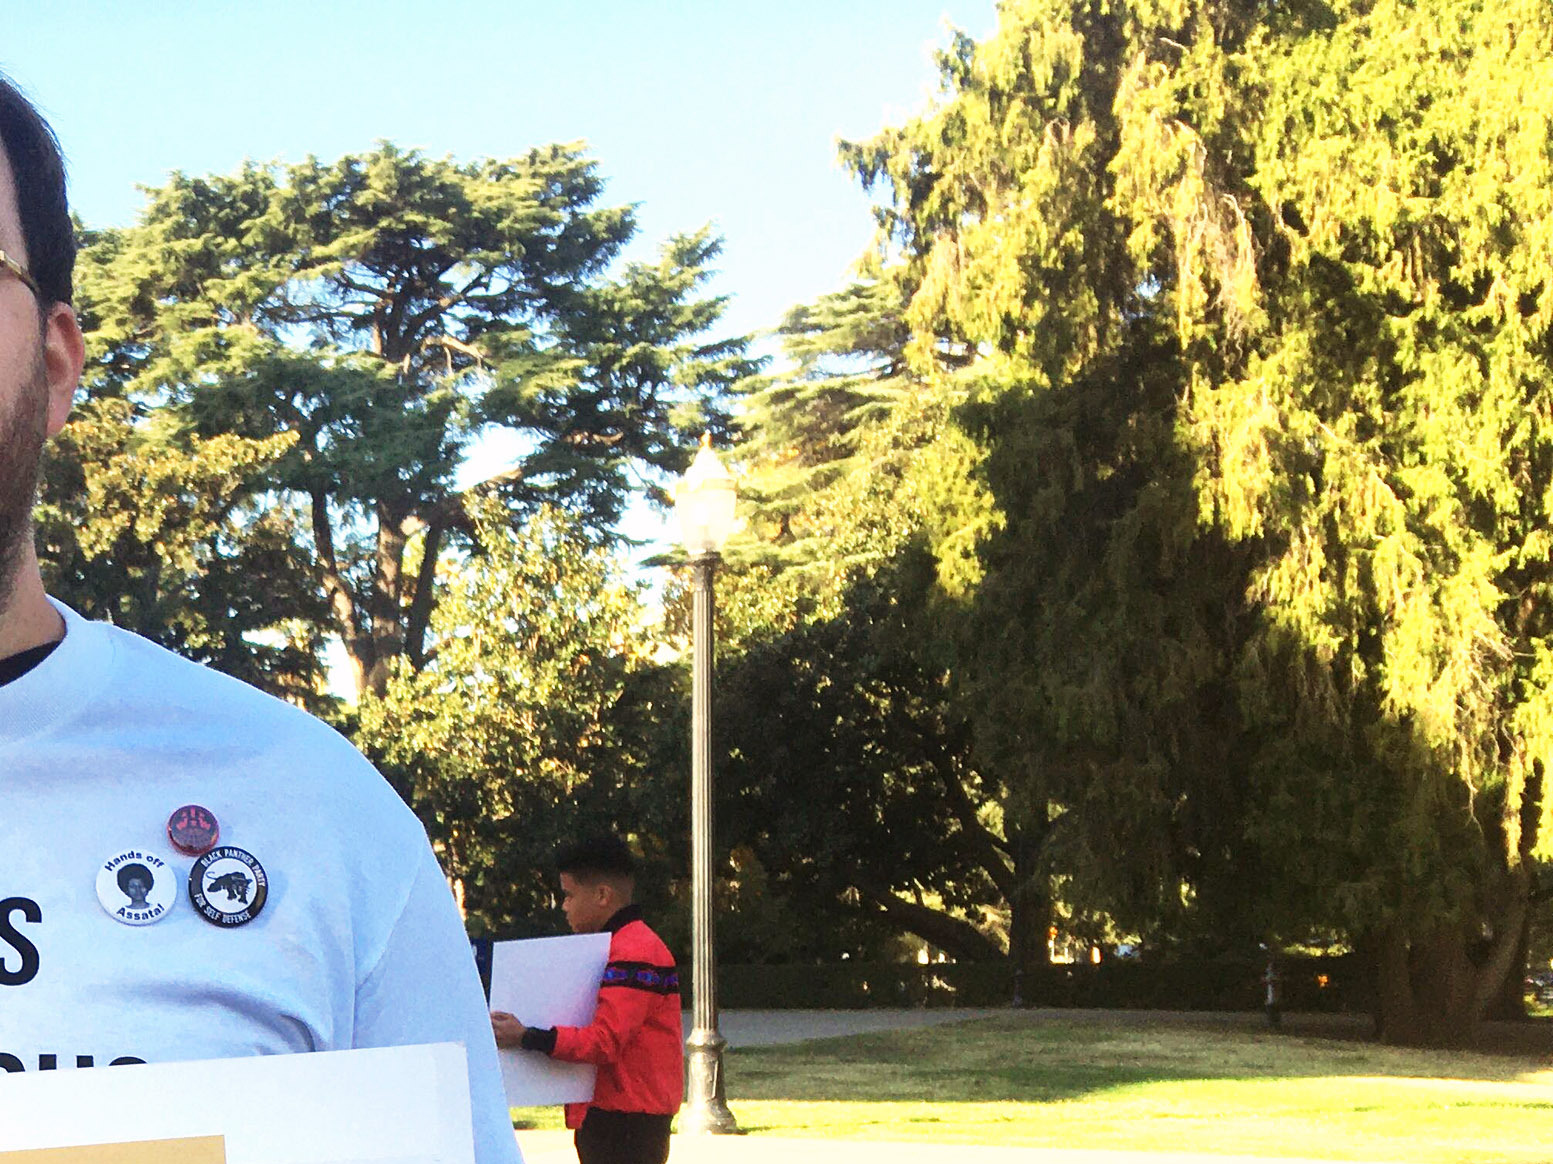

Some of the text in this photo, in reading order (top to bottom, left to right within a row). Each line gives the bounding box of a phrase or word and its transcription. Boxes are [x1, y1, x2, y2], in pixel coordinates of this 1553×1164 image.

[105, 851, 164, 871] Hands off
[201, 849, 265, 887] BLACK PANTHER PARTY
[116, 903, 164, 920] Assata!
[194, 893, 206, 908] FOR
[204, 905, 221, 920] SELF
